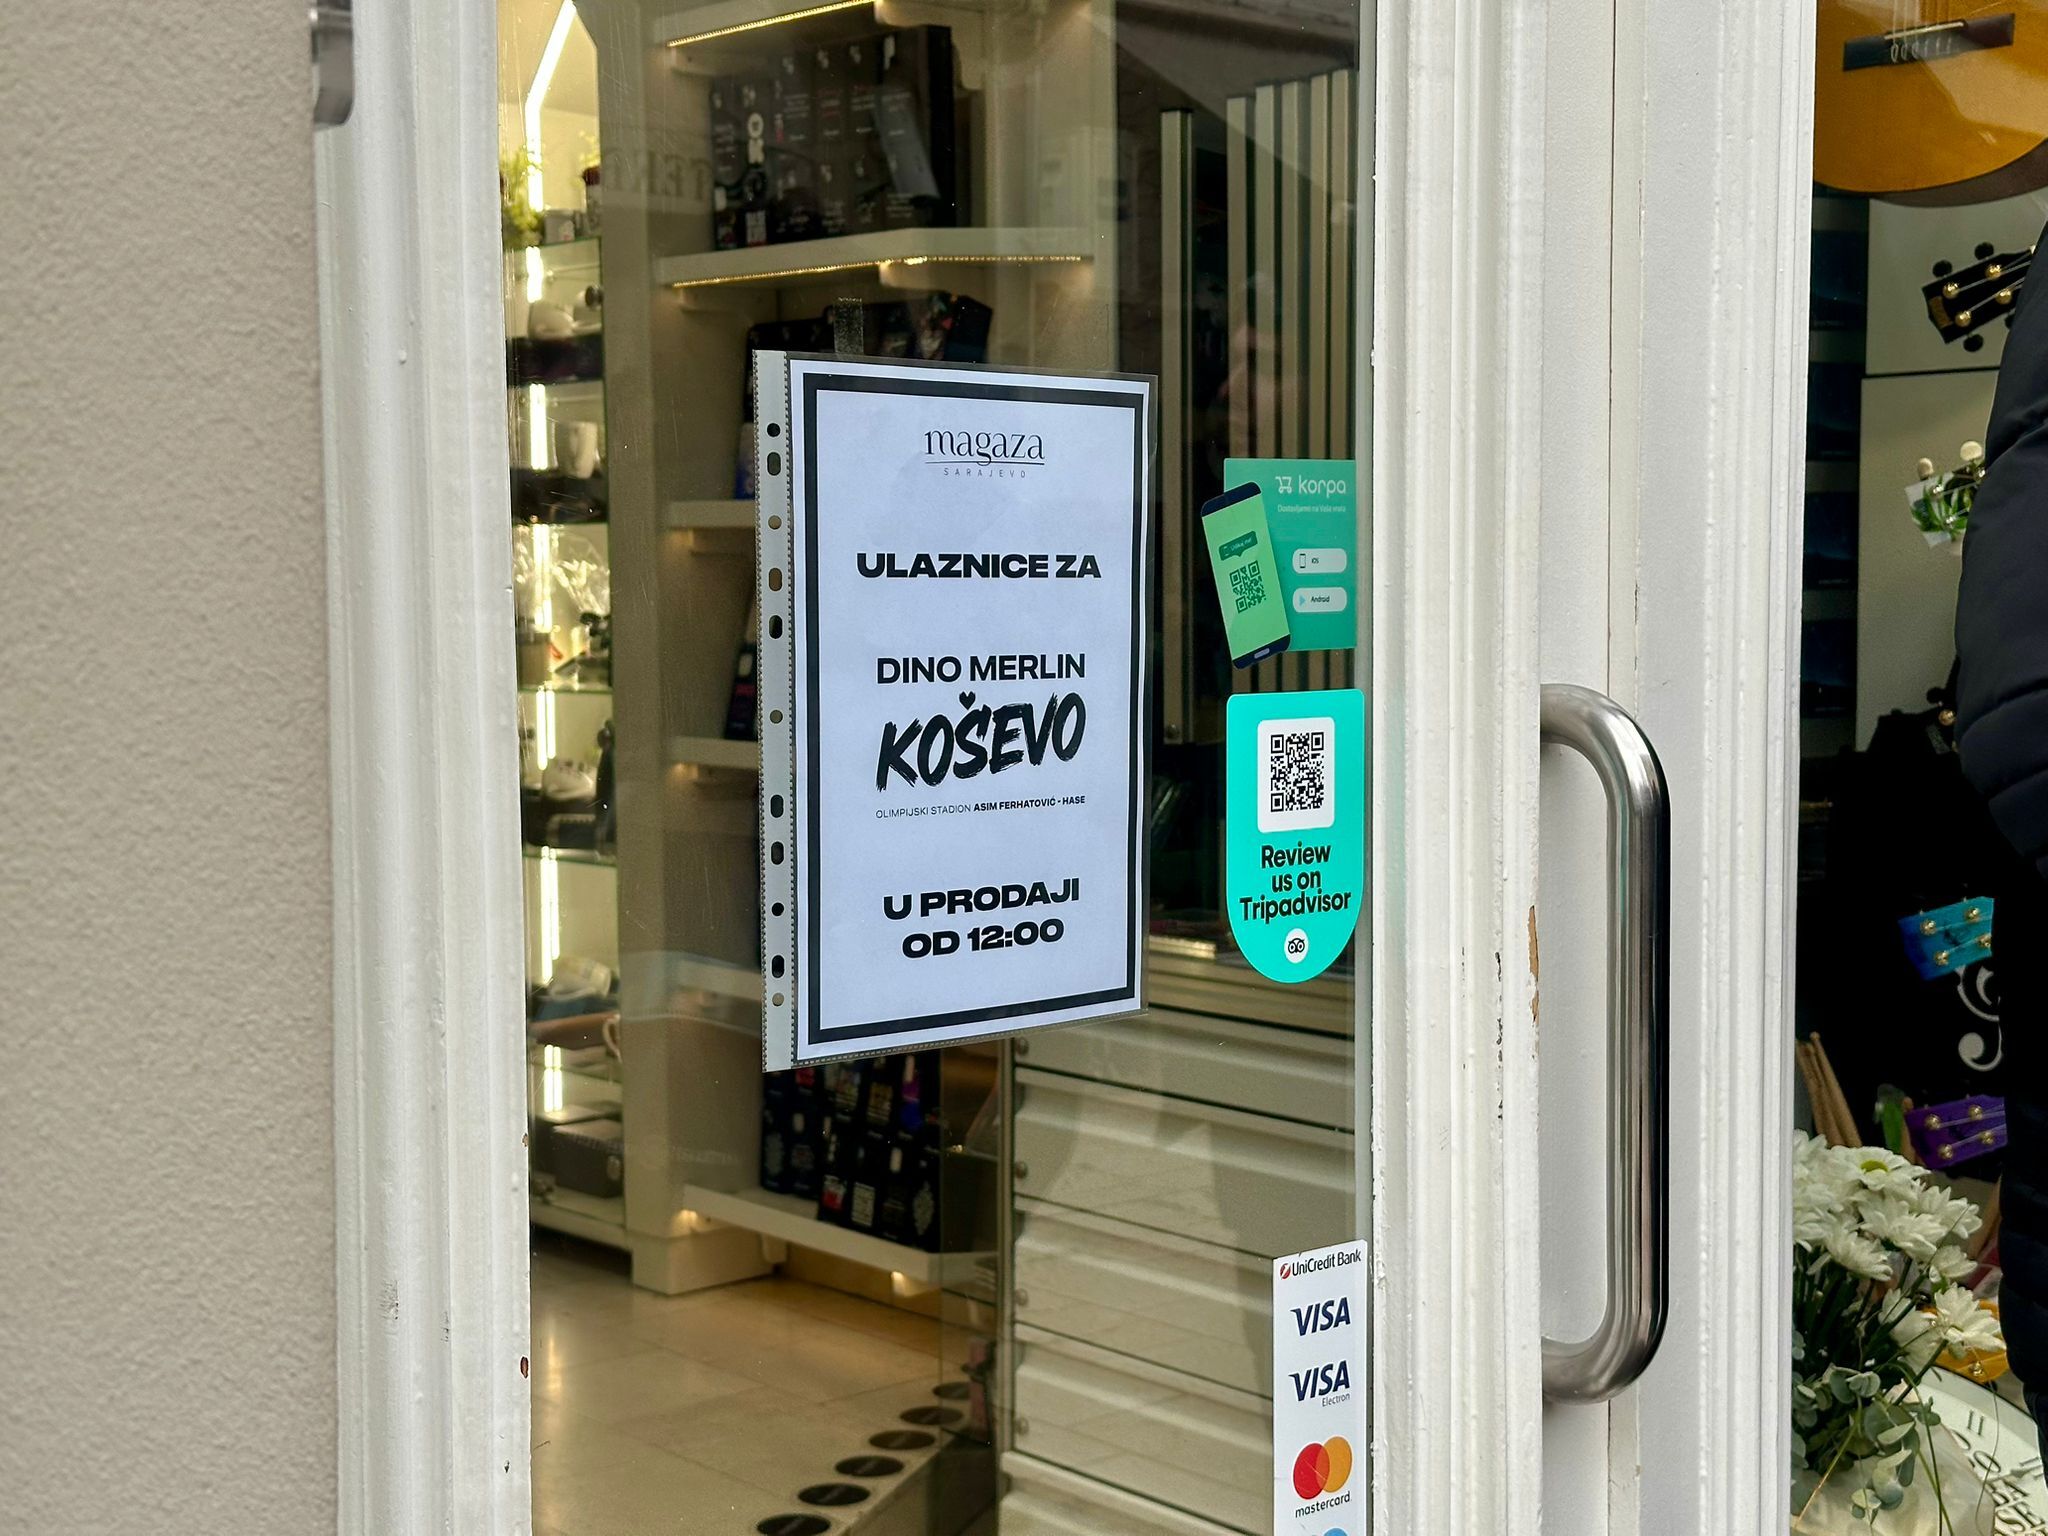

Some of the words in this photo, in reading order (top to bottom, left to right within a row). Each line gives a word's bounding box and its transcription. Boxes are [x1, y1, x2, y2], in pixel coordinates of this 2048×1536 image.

[925, 430, 1045, 466] magaza
[943, 468, 1026, 479] SARAJEVO
[1298, 474, 1346, 498] korpa
[857, 553, 1049, 578] ULAZNICE
[1055, 554, 1102, 578] ZA
[1310, 595, 1331, 604] Android
[877, 655, 961, 684] DINO
[970, 653, 1085, 681] MERLIN
[876, 691, 1086, 792] KOŠEVO
[876, 806, 929, 819] OLIMPIJSKI
[931, 804, 971, 816] STADION
[973, 802, 997, 812] ASIM
[999, 797, 1056, 811] FERHATOVIĆ
[1062, 795, 1085, 805] HASE
[1261, 841, 1331, 868] Review
[1271, 873, 1292, 893] us
[1297, 870, 1321, 890] on
[883, 895, 912, 920] U
[920, 878, 1080, 917] PRODAJI
[1240, 889, 1351, 924] Tripadvisor
[902, 930, 960, 958] OD
[967, 918, 1064, 951] 12:00
[1292, 1254, 1335, 1276] UniCredit
[1337, 1248, 1361, 1266] Bank
[1290, 1297, 1351, 1337] VISA
[1289, 1360, 1350, 1402] VISA
[1321, 1393, 1350, 1407] Electron
[1294, 1490, 1350, 1519] mastercard
